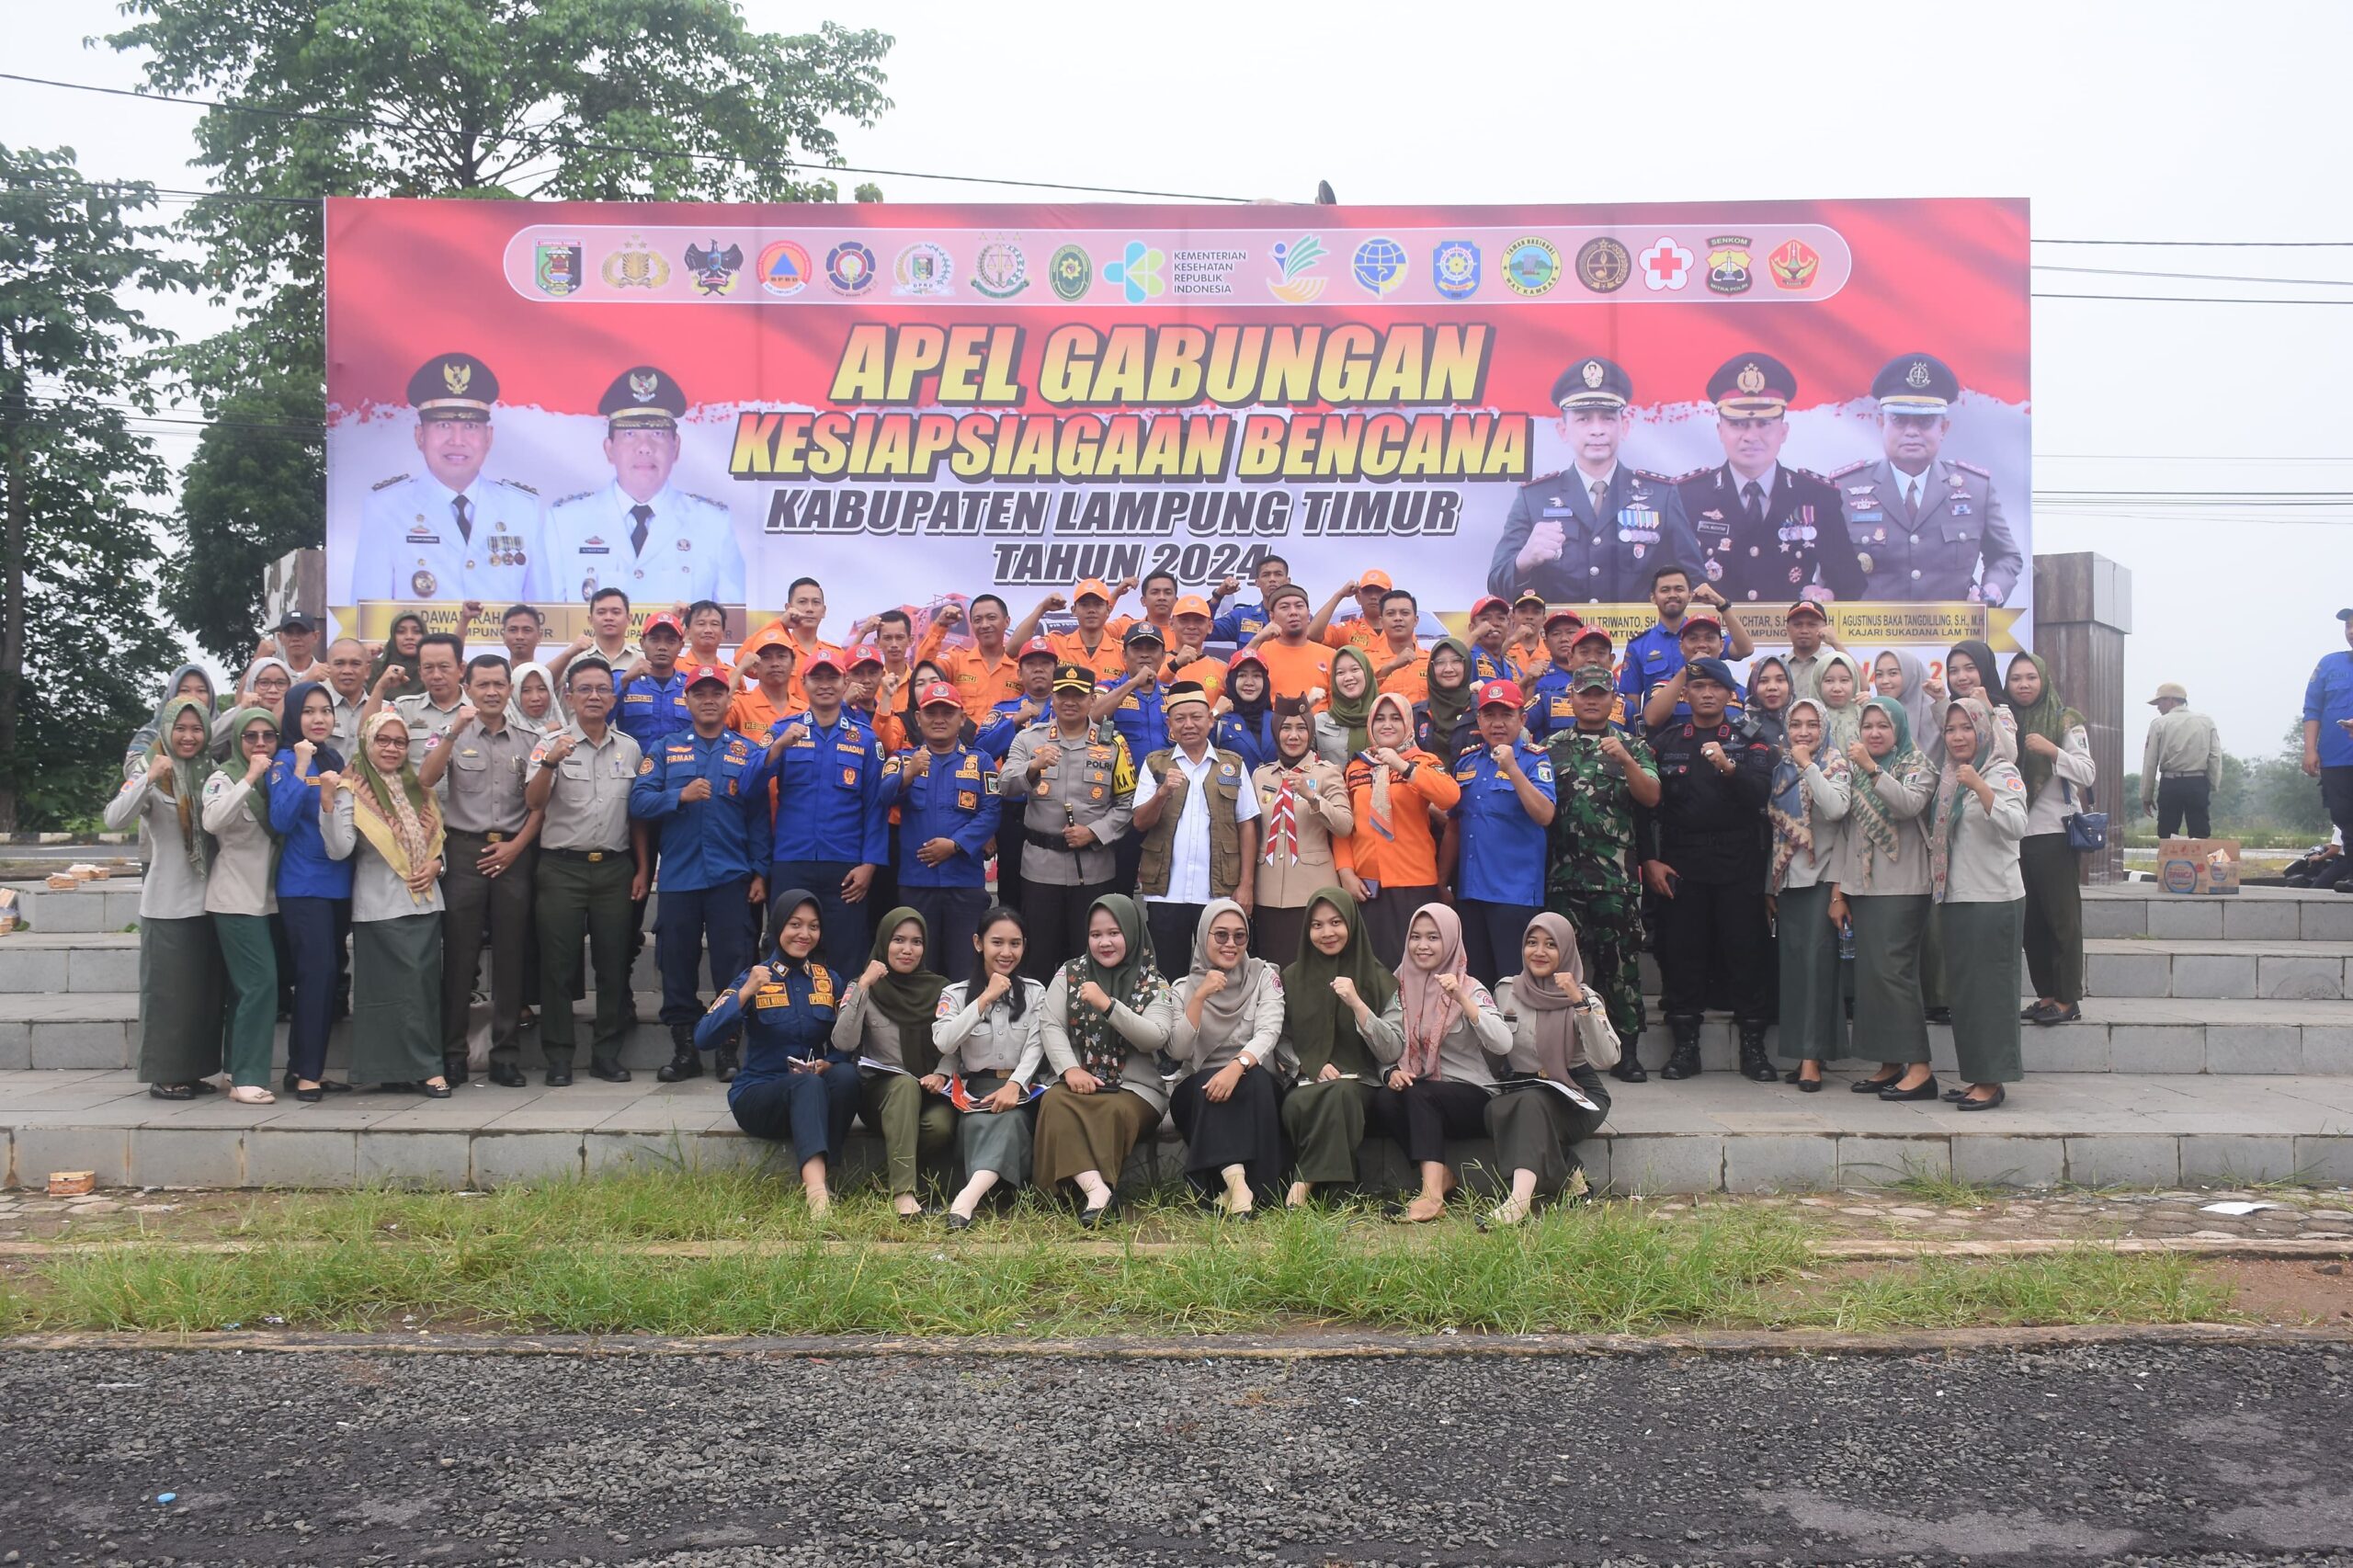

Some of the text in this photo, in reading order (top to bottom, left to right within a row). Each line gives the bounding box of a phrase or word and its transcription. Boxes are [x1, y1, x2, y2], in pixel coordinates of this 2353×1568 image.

[1506, 238, 1556, 256] TAMAN NASIONAL
[1711, 237, 1748, 246] SENKOM
[1174, 251, 1247, 261] KEMENTERIAN
[1174, 262, 1233, 272] KESEHATAN
[1174, 274, 1223, 282] REPUBLIK
[1174, 284, 1233, 294] INDONESIA
[1506, 277, 1557, 295] WAY KAMBAS
[829, 324, 1491, 406] APEL GABUNGAN
[729, 413, 1532, 482] KESIAPSIAGAAN BENCANA
[765, 488, 1461, 535] KABUPATEN LAMPUNG TIMUR
[994, 542, 1271, 585] TAHUN 2024
[1597, 616, 1643, 629] TRIWANTO,
[1842, 615, 1882, 626] AGUSTINUS
[1883, 615, 1903, 626] BAKA
[1848, 629, 1981, 637] KAJARI SUKADANA LAM TIM
[836, 743, 865, 756] PEMADAM
[666, 754, 695, 764] FIRMAN
[1086, 760, 1112, 771] POLRI
[1115, 773, 1129, 790] KA
